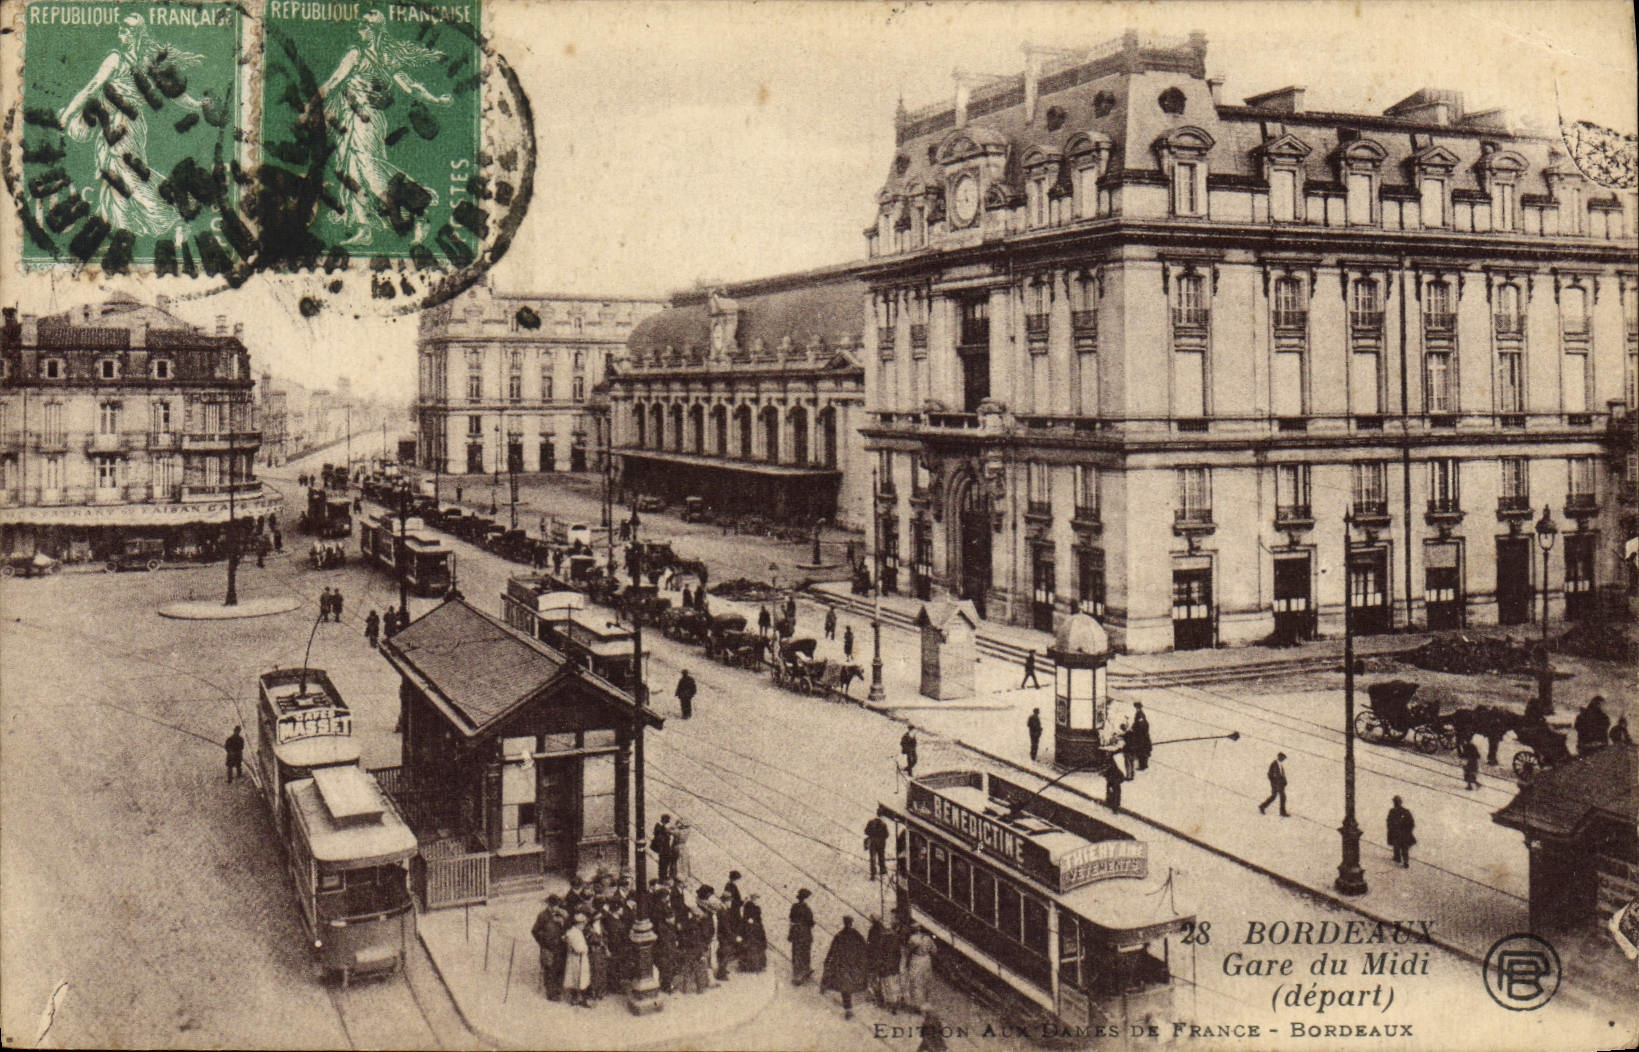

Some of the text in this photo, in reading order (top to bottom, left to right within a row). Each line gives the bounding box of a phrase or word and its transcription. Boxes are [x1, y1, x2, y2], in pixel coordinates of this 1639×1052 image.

[30, 6, 232, 28] REPUBLIQUE FRANÇAISE
[271, 1, 471, 24] REPUBLIQUE FRANÇAISE
